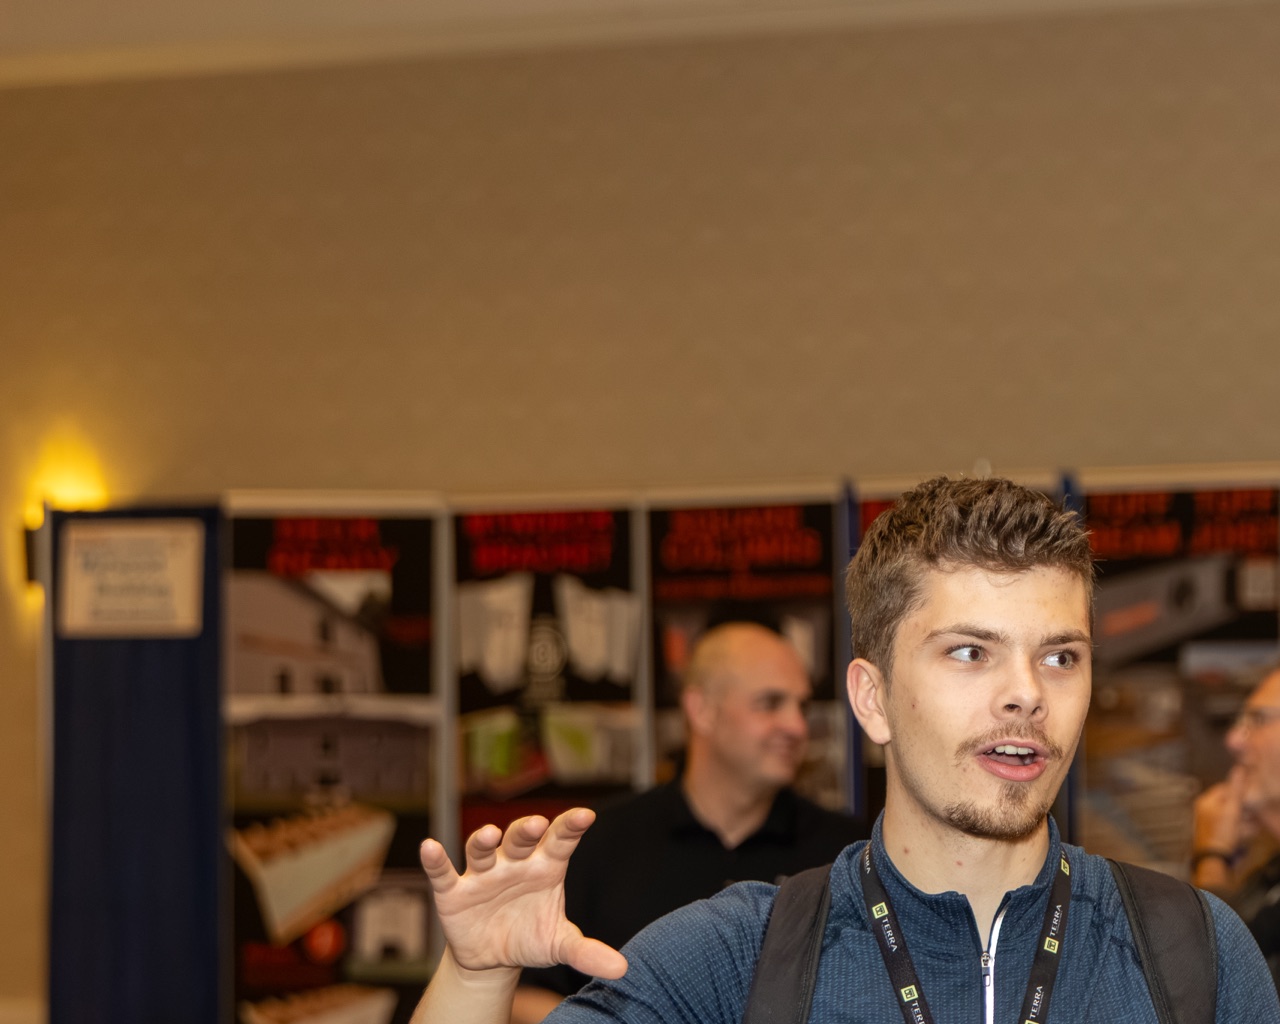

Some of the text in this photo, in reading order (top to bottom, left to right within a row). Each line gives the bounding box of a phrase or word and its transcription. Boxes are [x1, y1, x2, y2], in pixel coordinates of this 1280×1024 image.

[882, 916, 898, 952] TERRA
[1049, 904, 1062, 937] TERRA
[1029, 984, 1043, 1020] TERRA
